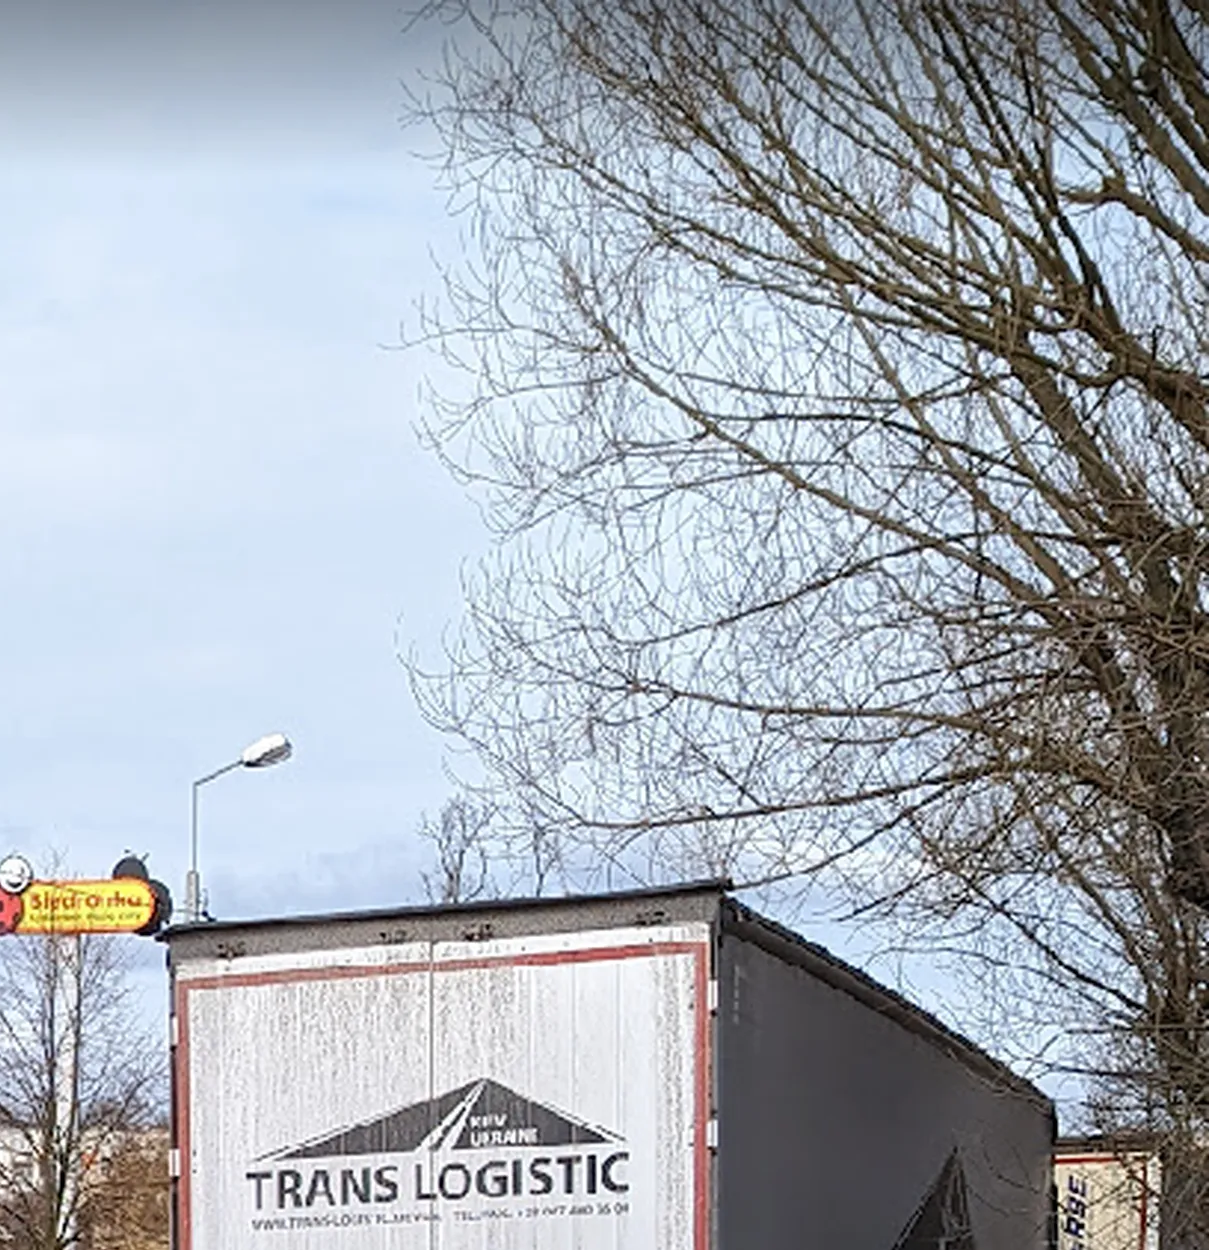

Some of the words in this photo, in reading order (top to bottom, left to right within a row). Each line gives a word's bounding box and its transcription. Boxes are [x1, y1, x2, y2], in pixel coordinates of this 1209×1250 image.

[470, 1128, 538, 1147] UKRAINE
[246, 1164, 399, 1211] TRANS
[415, 1151, 631, 1201] LOGISTIC
